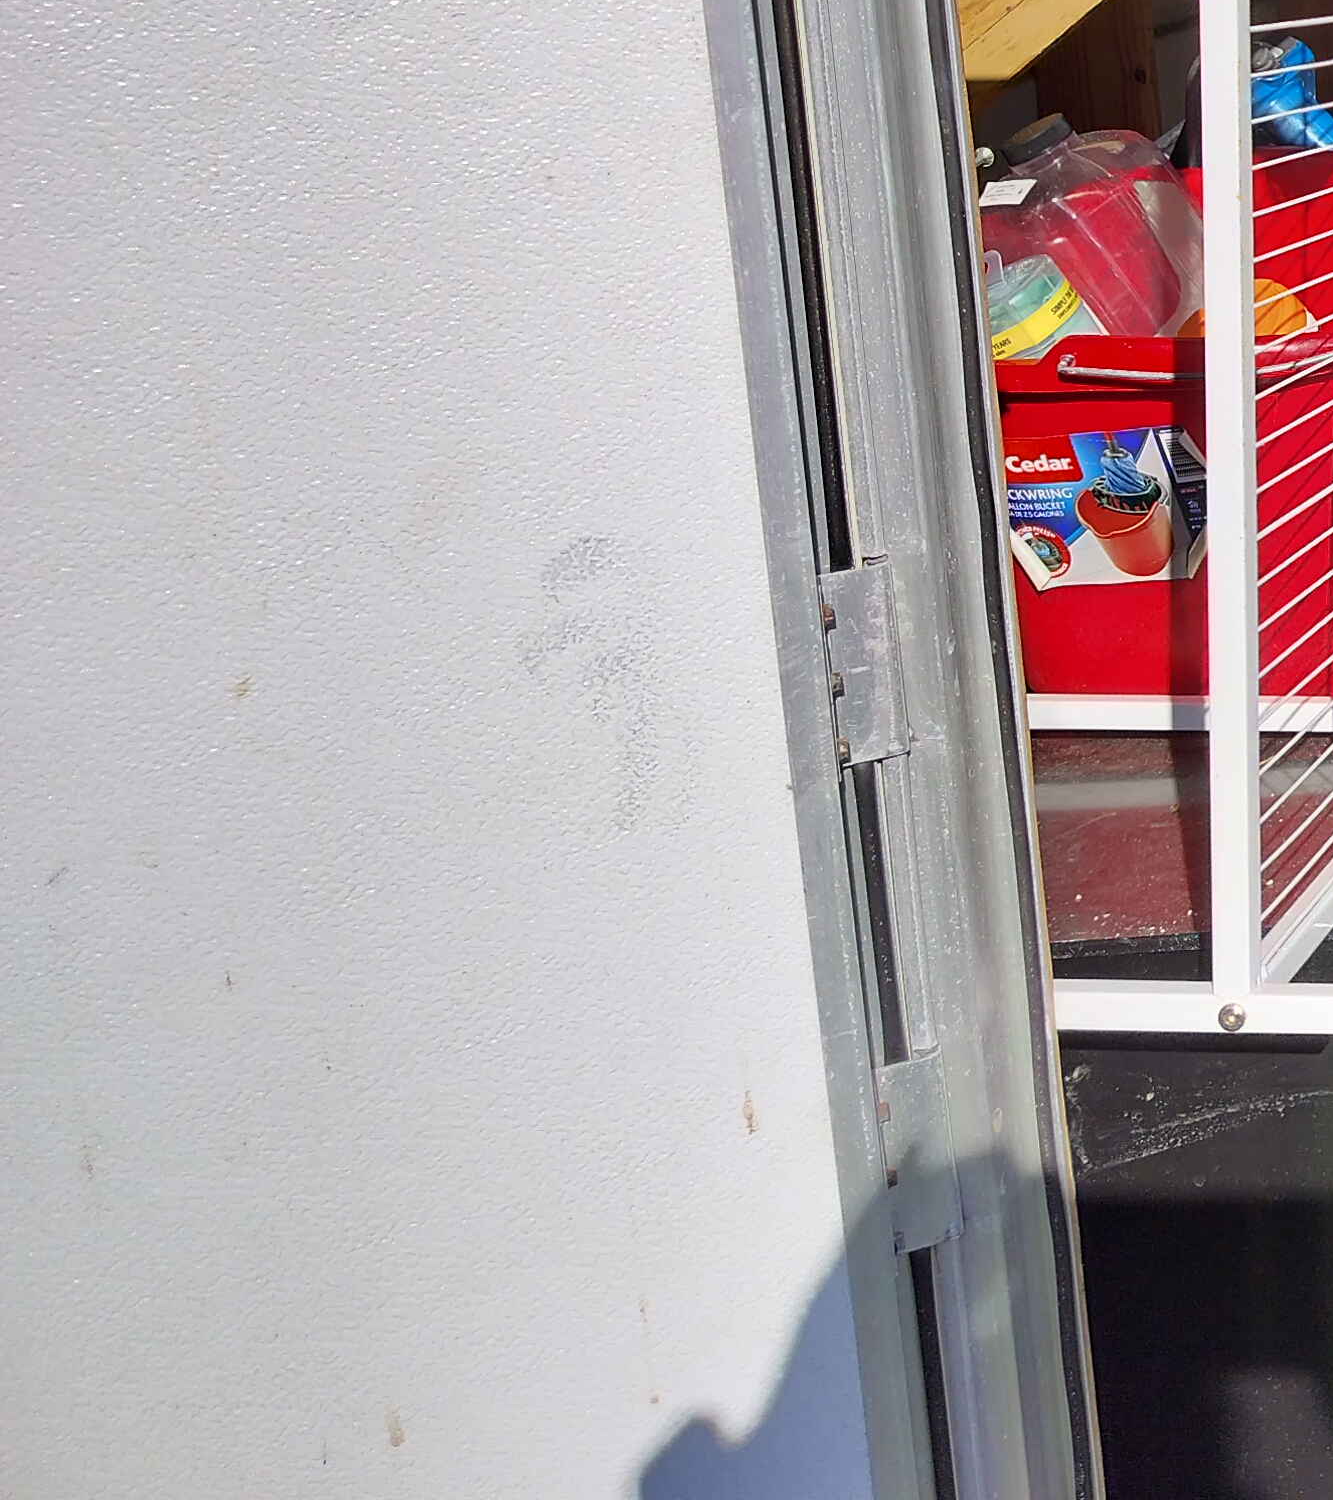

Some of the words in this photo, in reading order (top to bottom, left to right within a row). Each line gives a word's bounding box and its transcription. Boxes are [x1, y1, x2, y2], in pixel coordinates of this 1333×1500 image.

[992, 338, 1012, 351] YEARS
[1006, 486, 1073, 501] CKWRING
[1034, 501, 1066, 511] BUCKET
